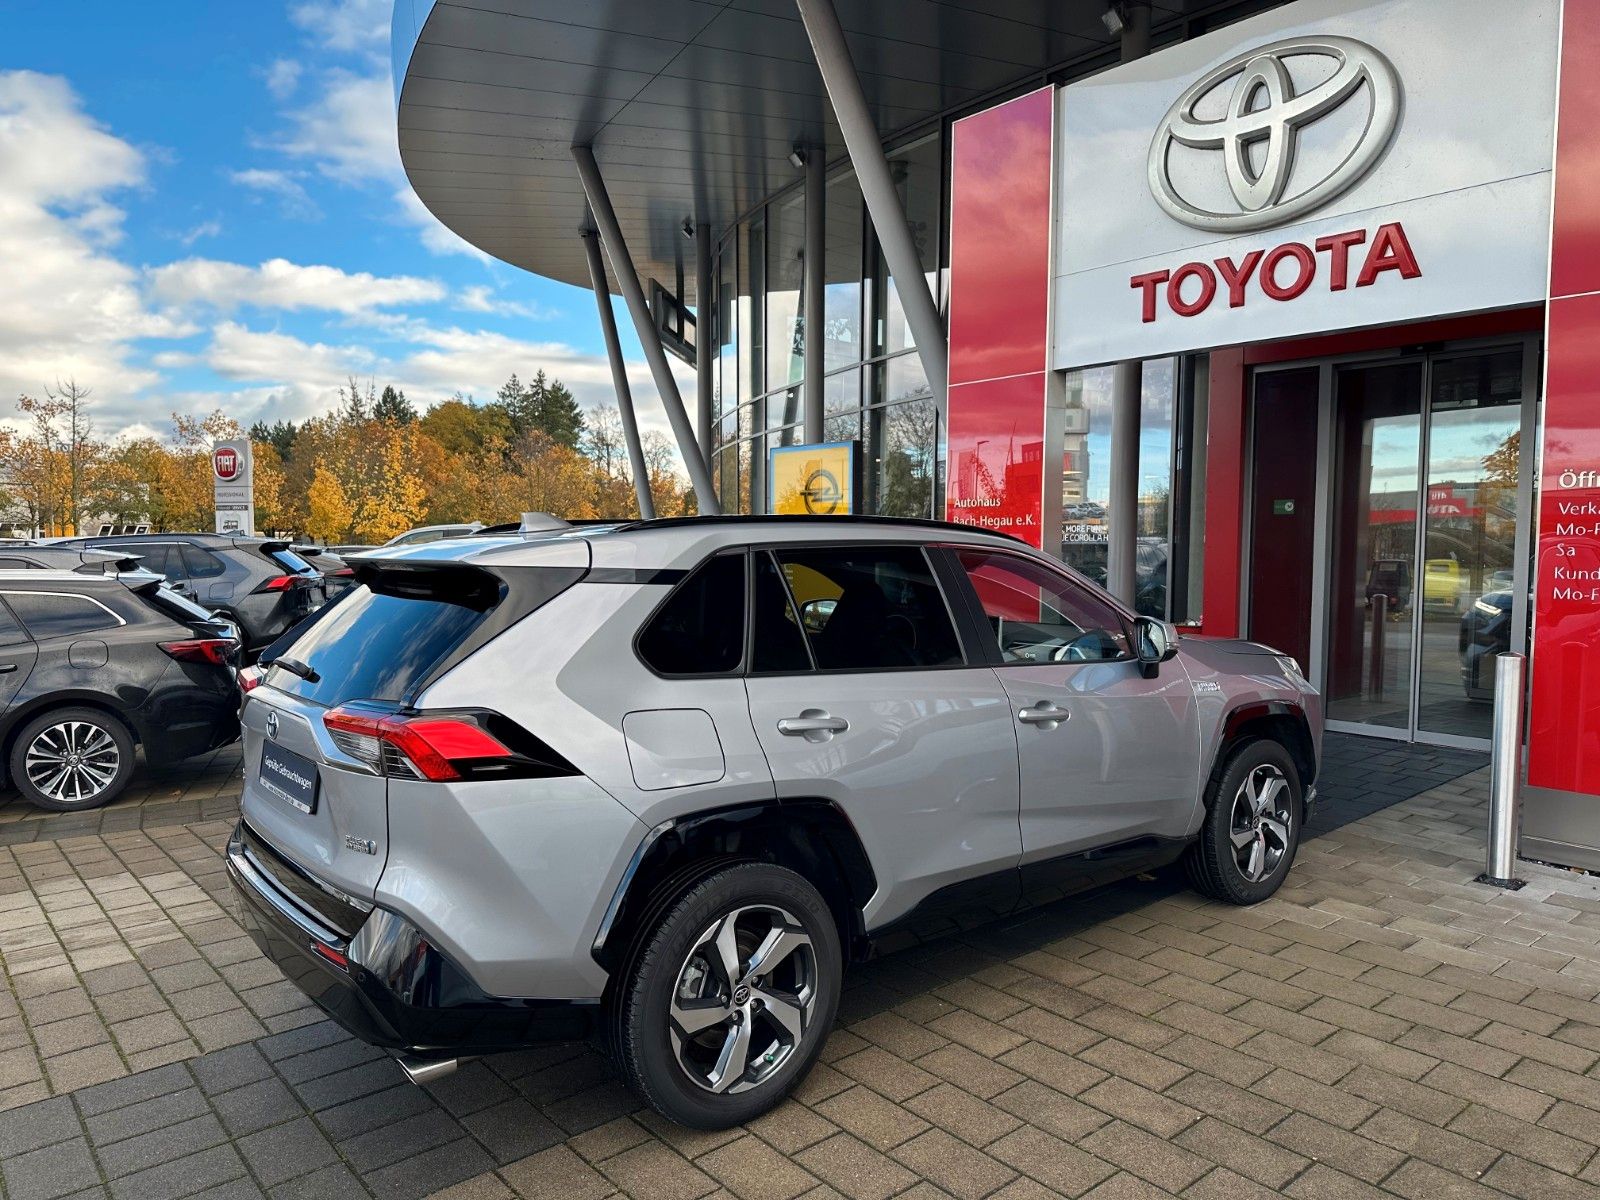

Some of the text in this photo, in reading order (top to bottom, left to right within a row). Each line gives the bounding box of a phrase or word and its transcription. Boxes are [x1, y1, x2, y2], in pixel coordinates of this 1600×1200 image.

[1130, 221, 1422, 323] TOYOTA
[217, 455, 235, 472] FIAT
[954, 496, 1001, 508] Autohaus
[953, 514, 1036, 529] Bach-Hegau e.K.
[1066, 525, 1086, 533] MORE
[1556, 543, 1576, 557] Sa
